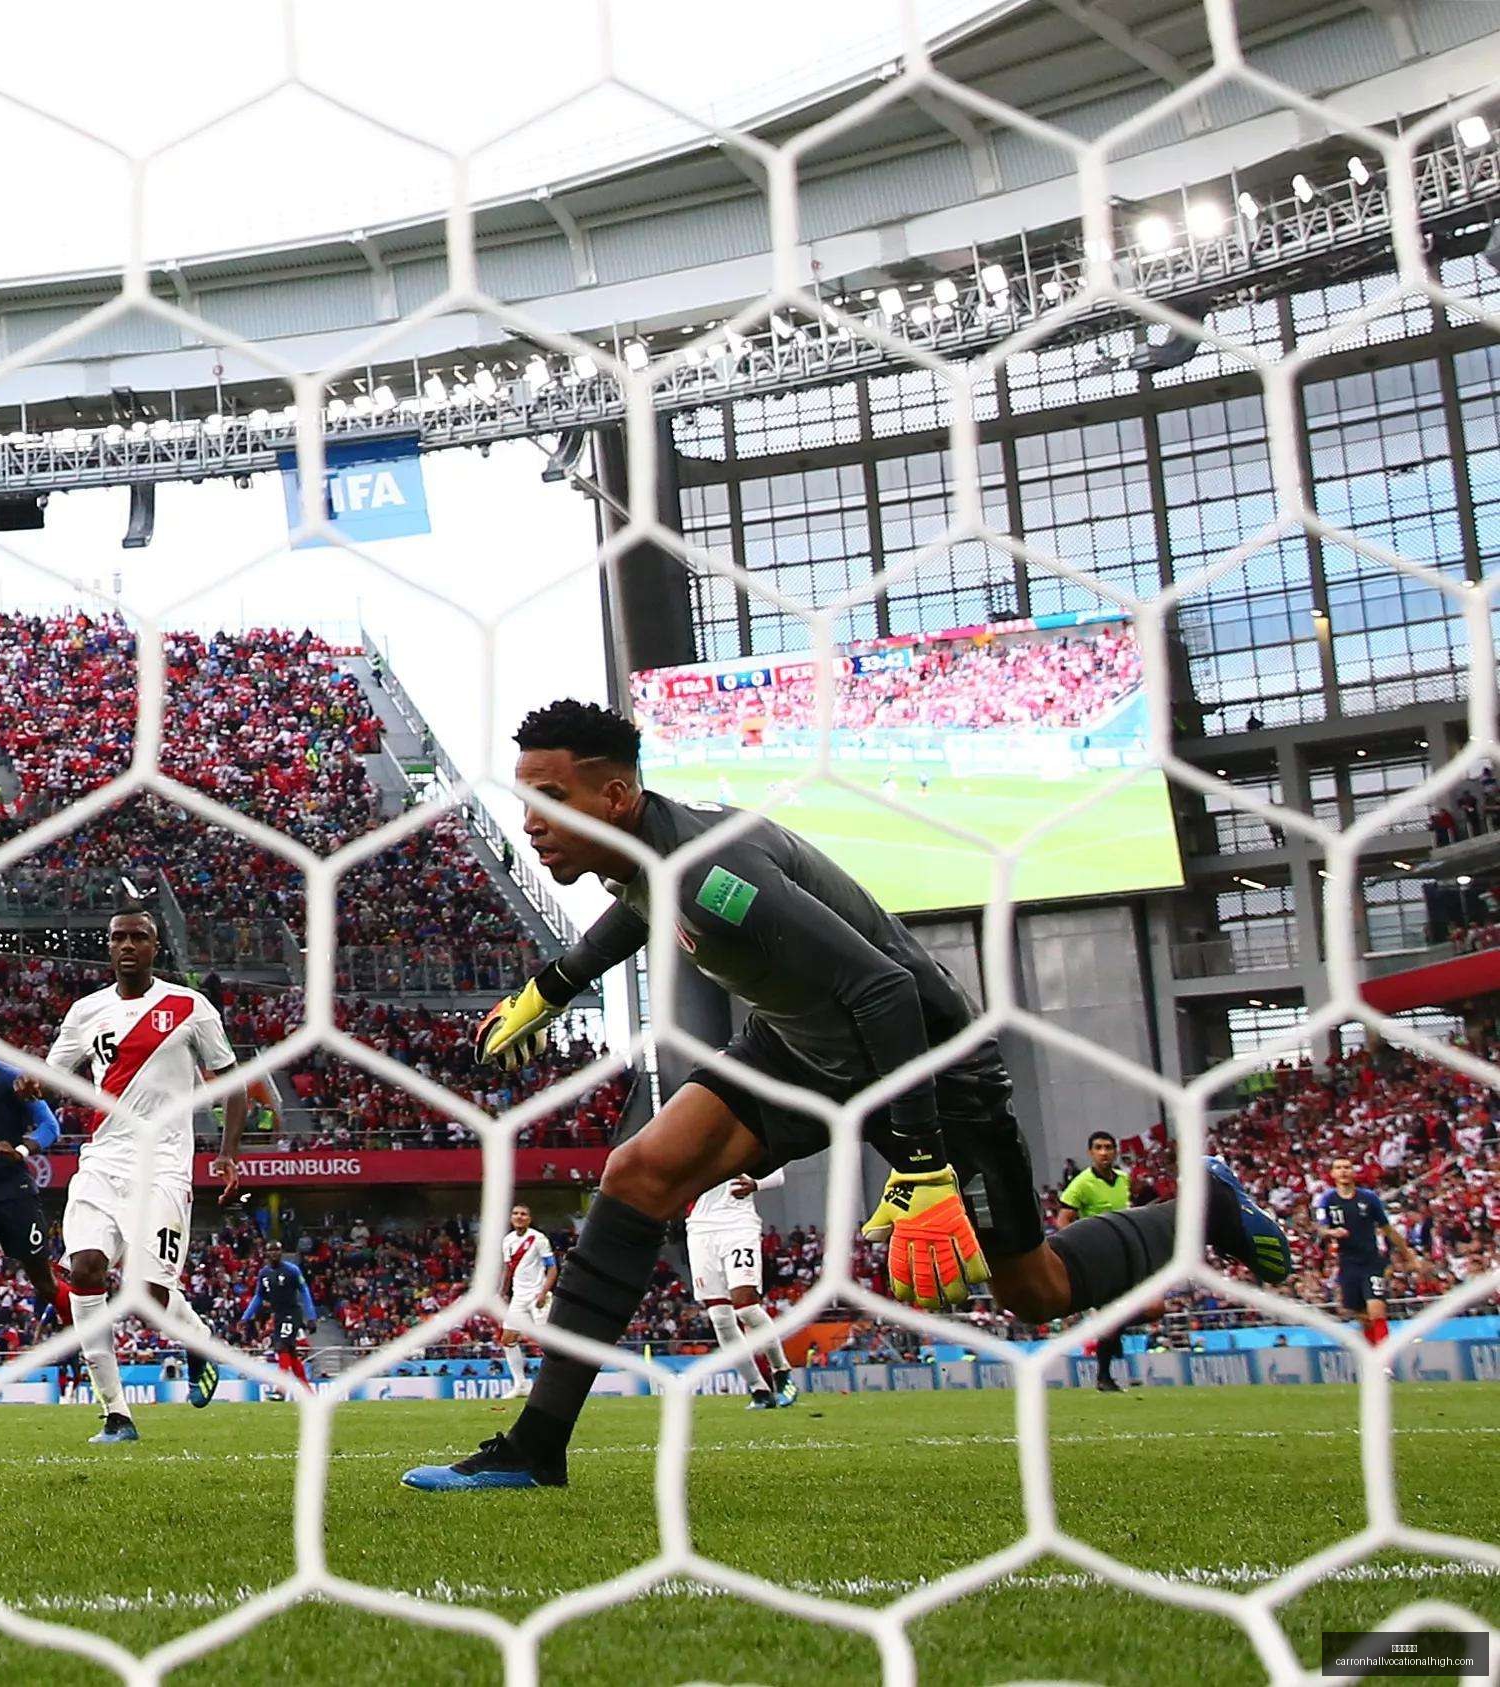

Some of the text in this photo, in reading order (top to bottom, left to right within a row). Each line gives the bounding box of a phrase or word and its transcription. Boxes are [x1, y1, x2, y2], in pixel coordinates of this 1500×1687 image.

[308, 471, 406, 513] IFA
[673, 679, 709, 696] FRA
[723, 673, 737, 690] 0
[751, 671, 765, 686] 0
[93, 1031, 119, 1066] 15
[208, 1159, 361, 1177] EATERINBURG
[1329, 1209, 1345, 1225] 21
[29, 1223, 43, 1246] 6
[156, 1226, 181, 1265] 15
[732, 1248, 755, 1268] 23
